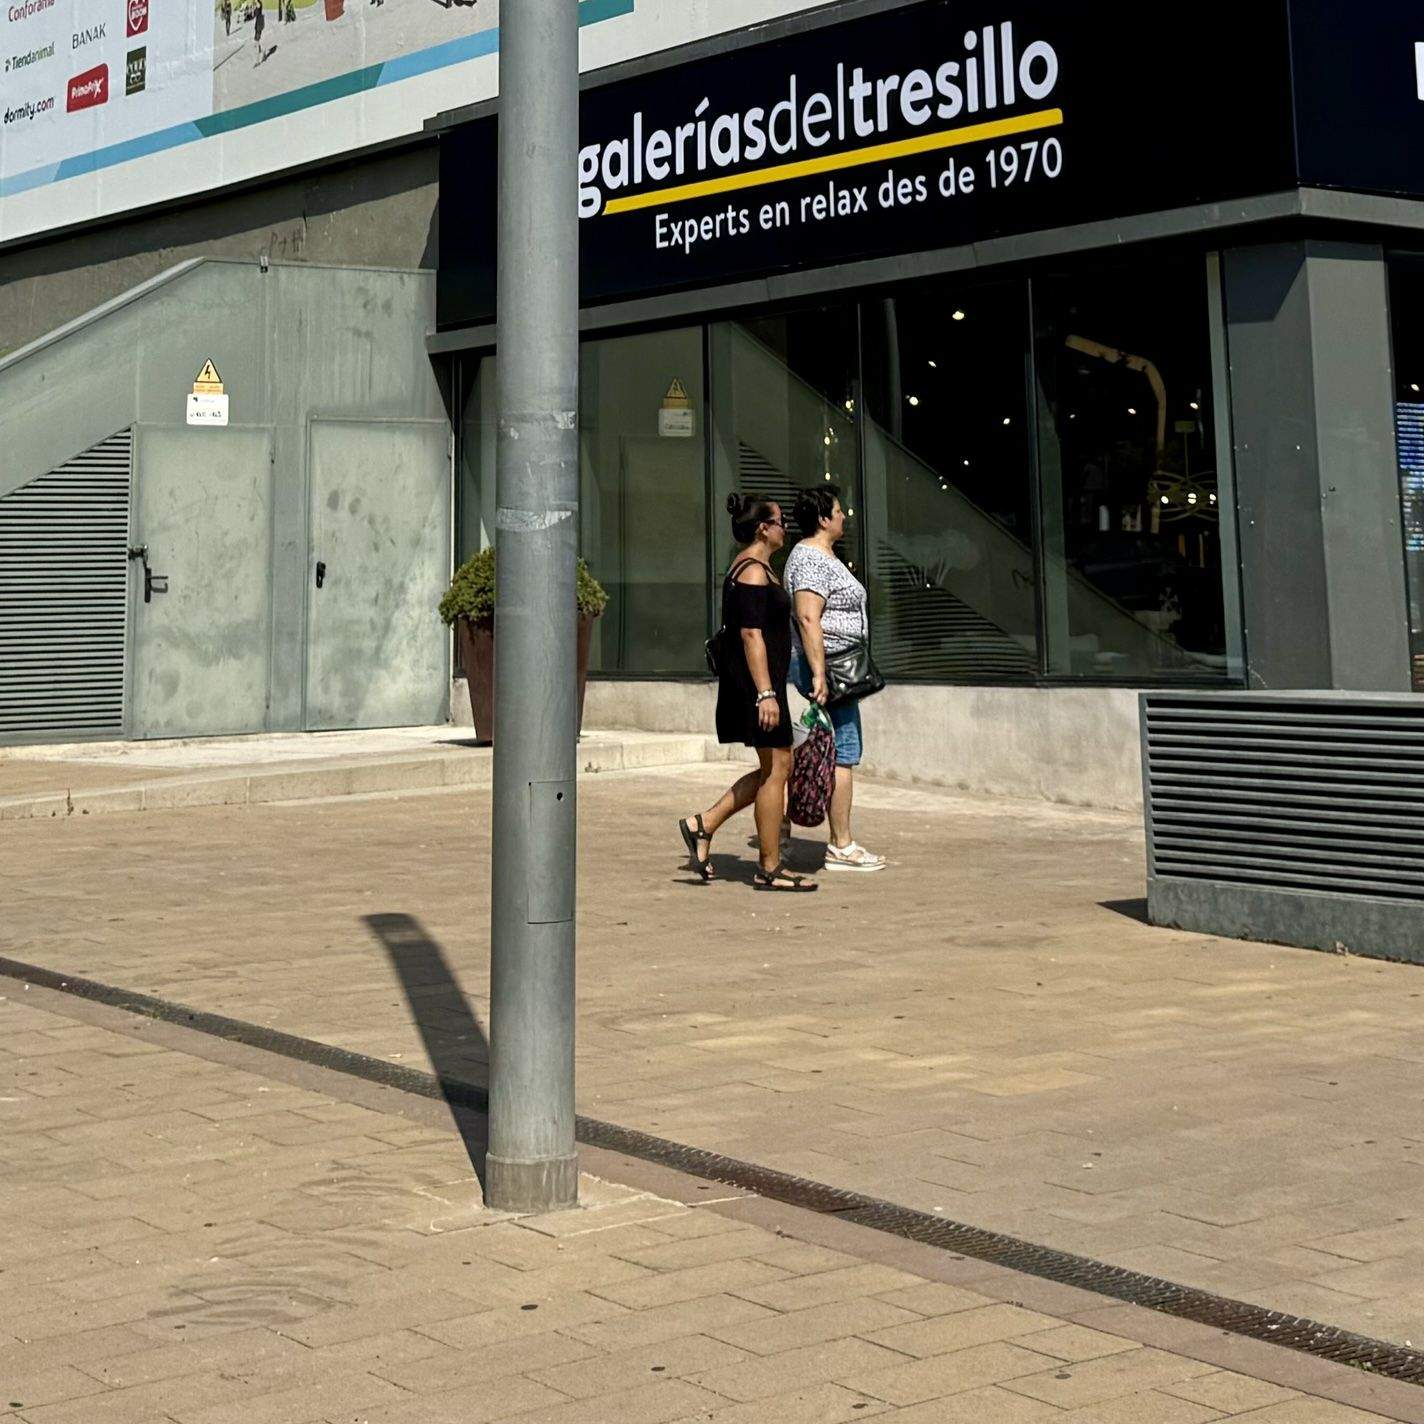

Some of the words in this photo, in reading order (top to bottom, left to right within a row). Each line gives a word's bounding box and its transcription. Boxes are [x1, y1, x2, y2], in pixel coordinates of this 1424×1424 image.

[72, 23, 106, 49] BANAK
[12, 41, 55, 70] Tiendanimal
[4, 96, 54, 124] dormity.com
[578, 21, 1059, 218] galeríasdeltresillo
[655, 205, 750, 253] Experts
[759, 199, 790, 230] en
[800, 180, 867, 221] relax
[878, 170, 927, 208] des
[938, 157, 975, 196] de
[986, 137, 1063, 187] 1970
